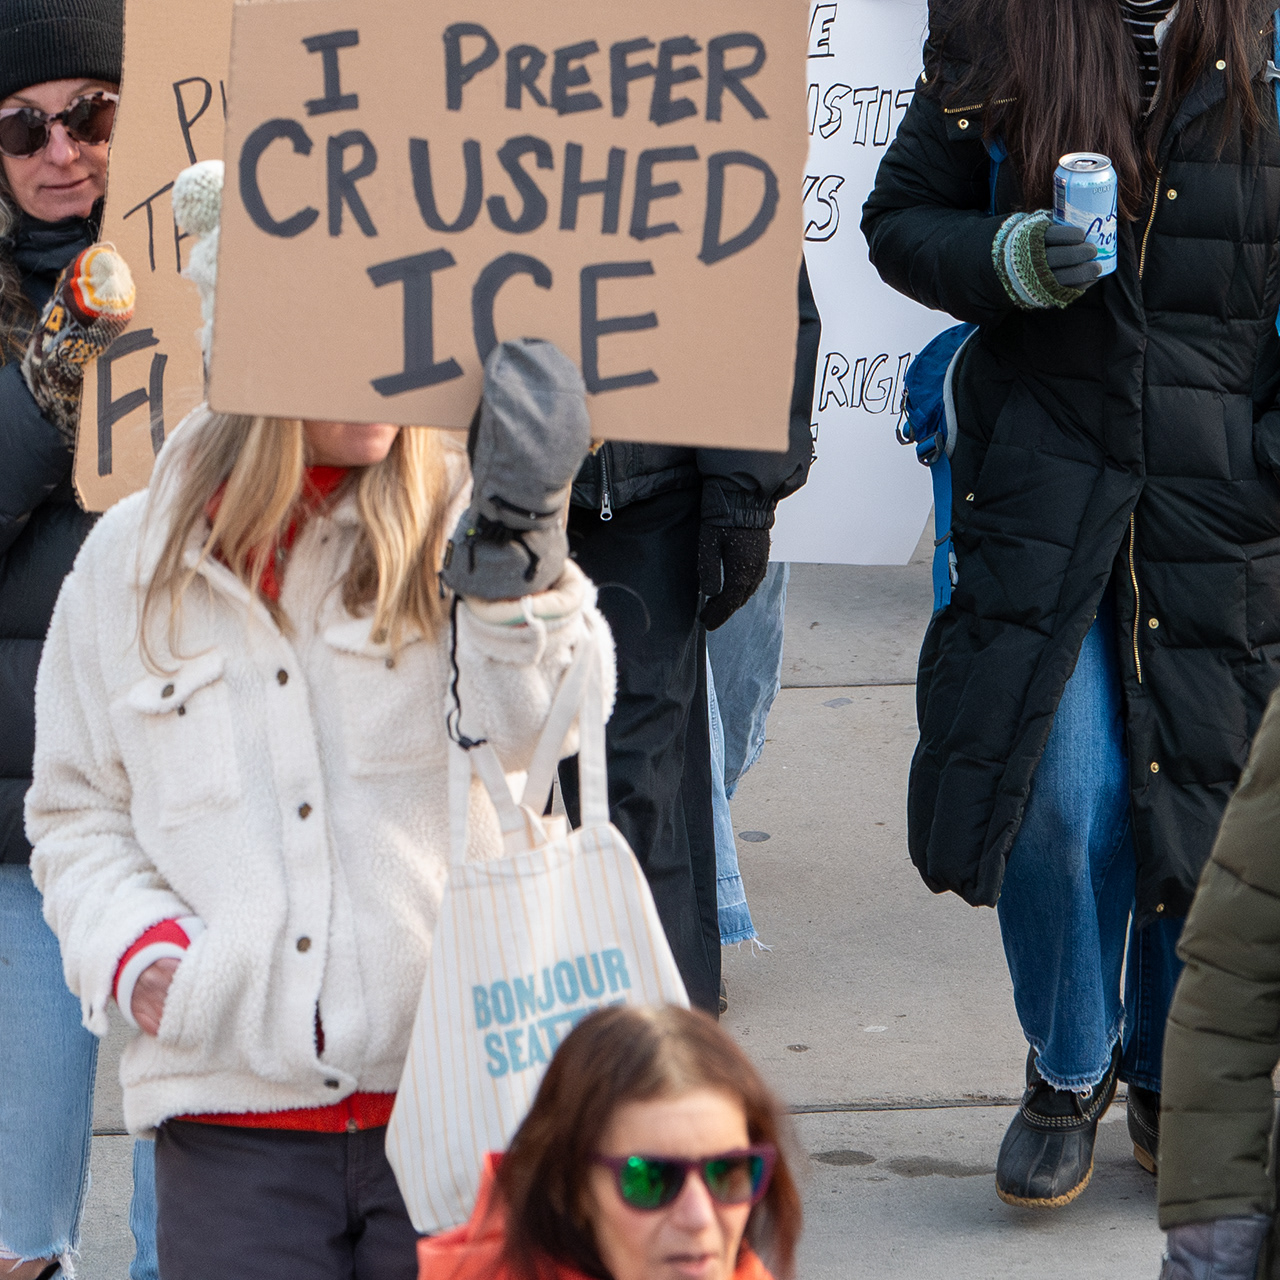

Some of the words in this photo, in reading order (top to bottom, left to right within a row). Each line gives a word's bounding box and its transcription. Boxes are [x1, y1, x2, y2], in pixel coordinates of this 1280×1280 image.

[301, 29, 360, 116] I
[442, 21, 770, 127] PREFER
[238, 117, 780, 265] CRUSHED
[366, 248, 660, 398] ICE
[472, 948, 632, 1030] BONJOUR
[484, 997, 627, 1079] SEAT
